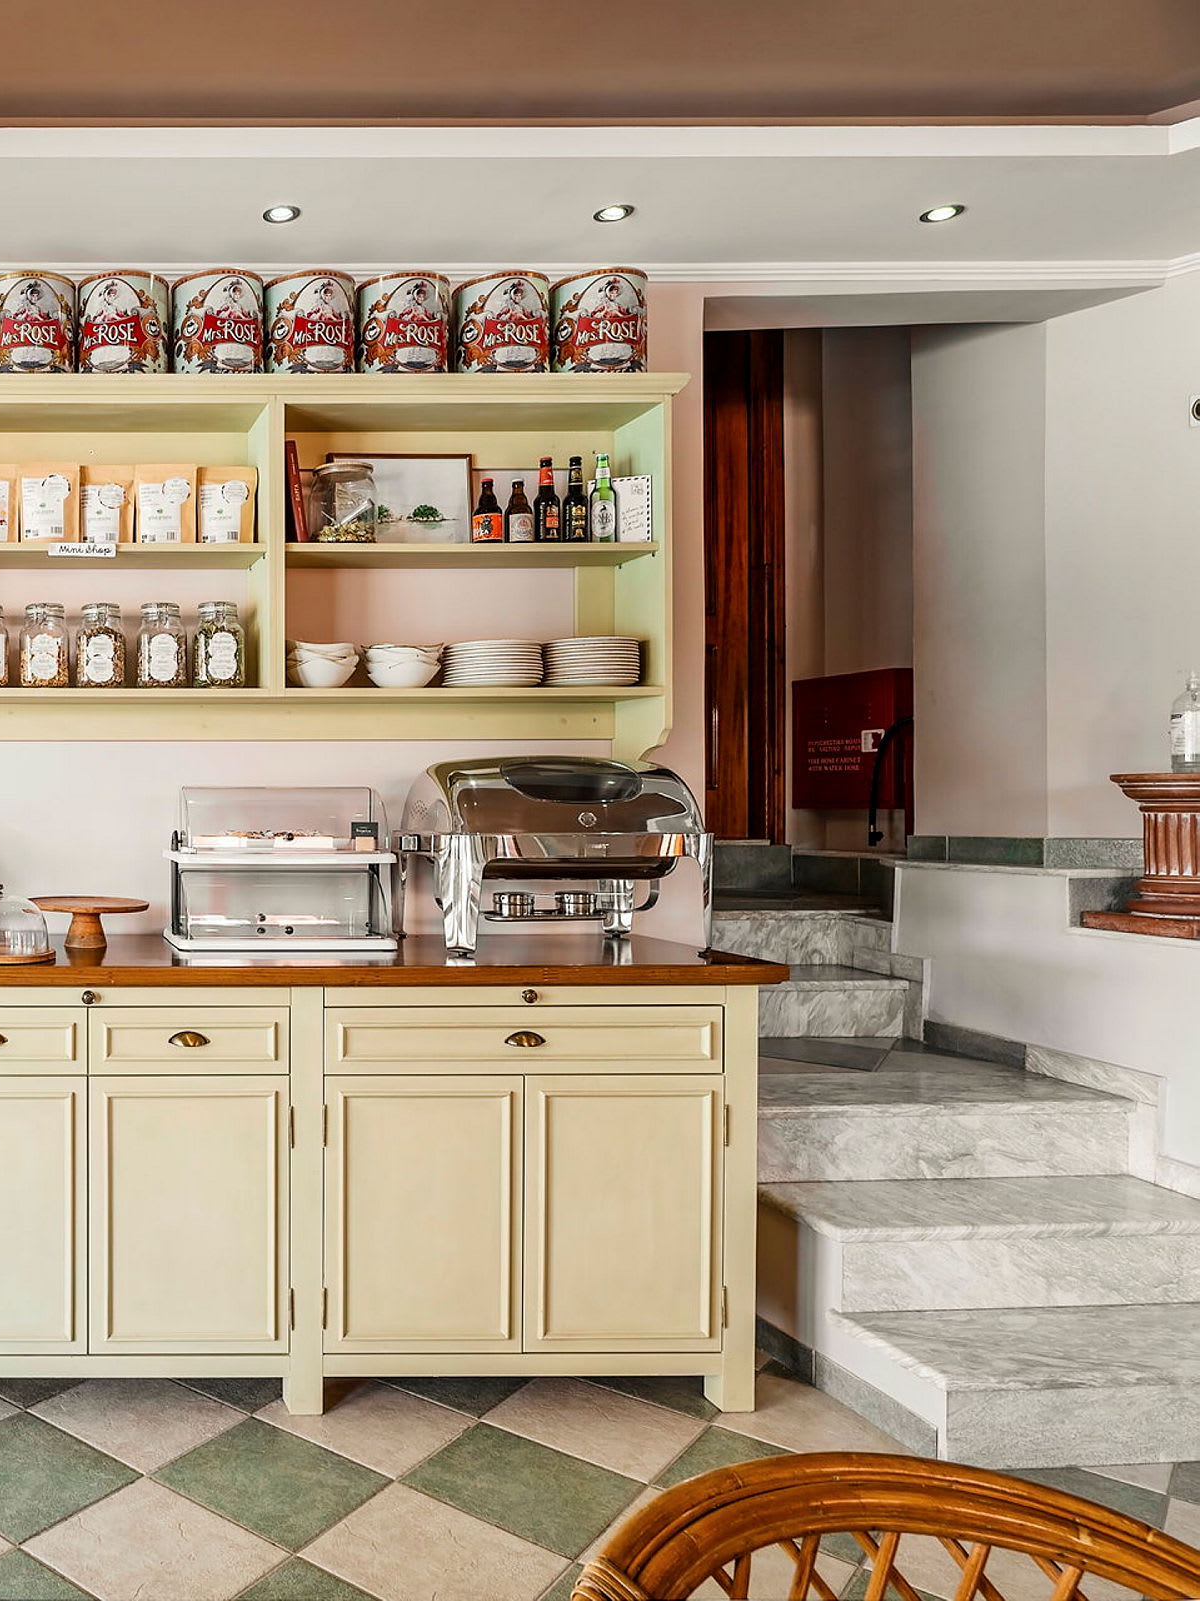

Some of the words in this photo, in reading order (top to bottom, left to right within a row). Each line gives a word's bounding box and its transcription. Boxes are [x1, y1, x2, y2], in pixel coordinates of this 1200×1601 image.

[14, 323, 58, 346] ROSE
[93, 322, 137, 344] ROSE
[203, 328, 224, 342] Mrs.
[217, 320, 258, 344] ROSE
[293, 330, 314, 345] Mrs.
[399, 323, 441, 346] ROSE
[497, 322, 541, 344] ROSE
[591, 320, 636, 342] ROSE
[59, 545, 84, 554] Mini
[85, 544, 112, 556] Shop
